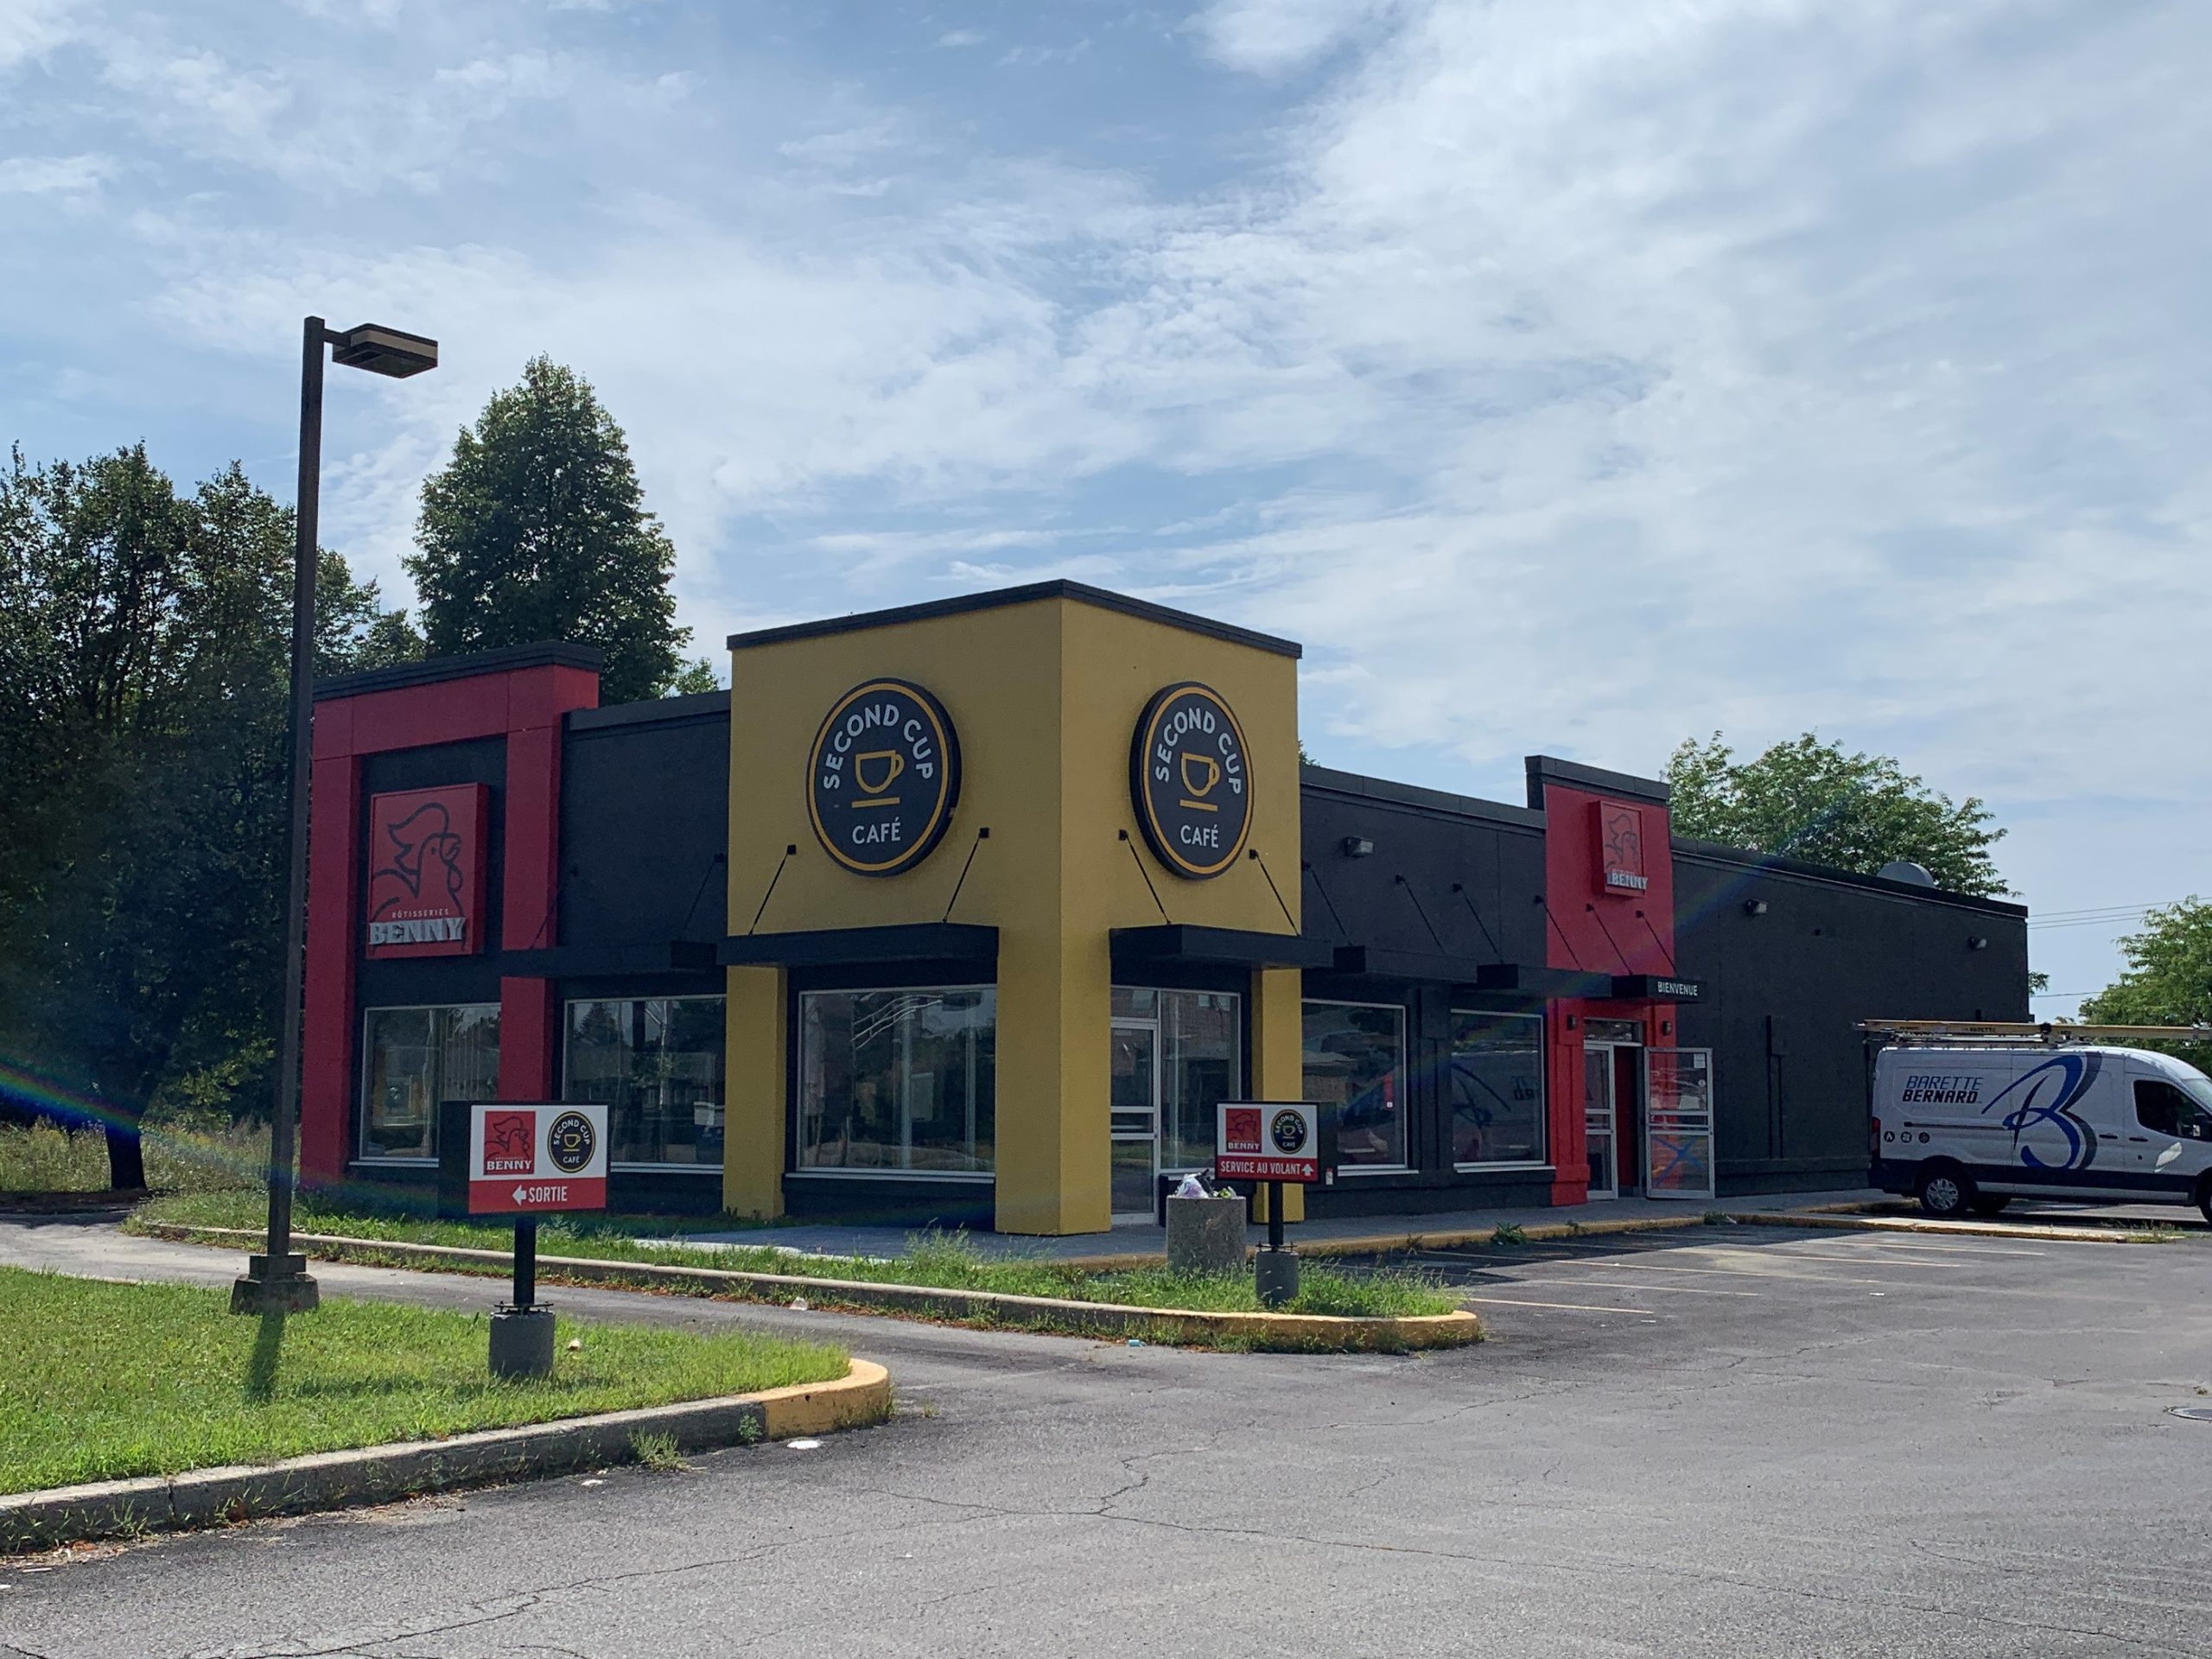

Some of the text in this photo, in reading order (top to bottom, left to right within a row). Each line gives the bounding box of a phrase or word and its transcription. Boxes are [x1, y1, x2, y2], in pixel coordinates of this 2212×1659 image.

[823, 704, 933, 790] SECOND CUP
[1155, 707, 1242, 795] SECOND CUP
[852, 817, 901, 844] CAFÉ
[1180, 824, 1219, 849] CAFÉ
[1611, 872, 1649, 890] BENNY
[369, 918, 466, 945] BENNY
[1657, 981, 1698, 996] BIENVENUE
[1905, 1075, 1983, 1090] BARETTE
[1902, 1089, 1979, 1103] BERNARD
[553, 1119, 590, 1146] SECOND CUP
[1274, 1115, 1304, 1135] SECOND CUP
[486, 1160, 531, 1171] BENNY
[563, 1155, 580, 1164] CAFÉ
[1220, 1160, 1301, 1174] SERVICE AU VOLANT
[528, 1185, 568, 1203] SORTIE
